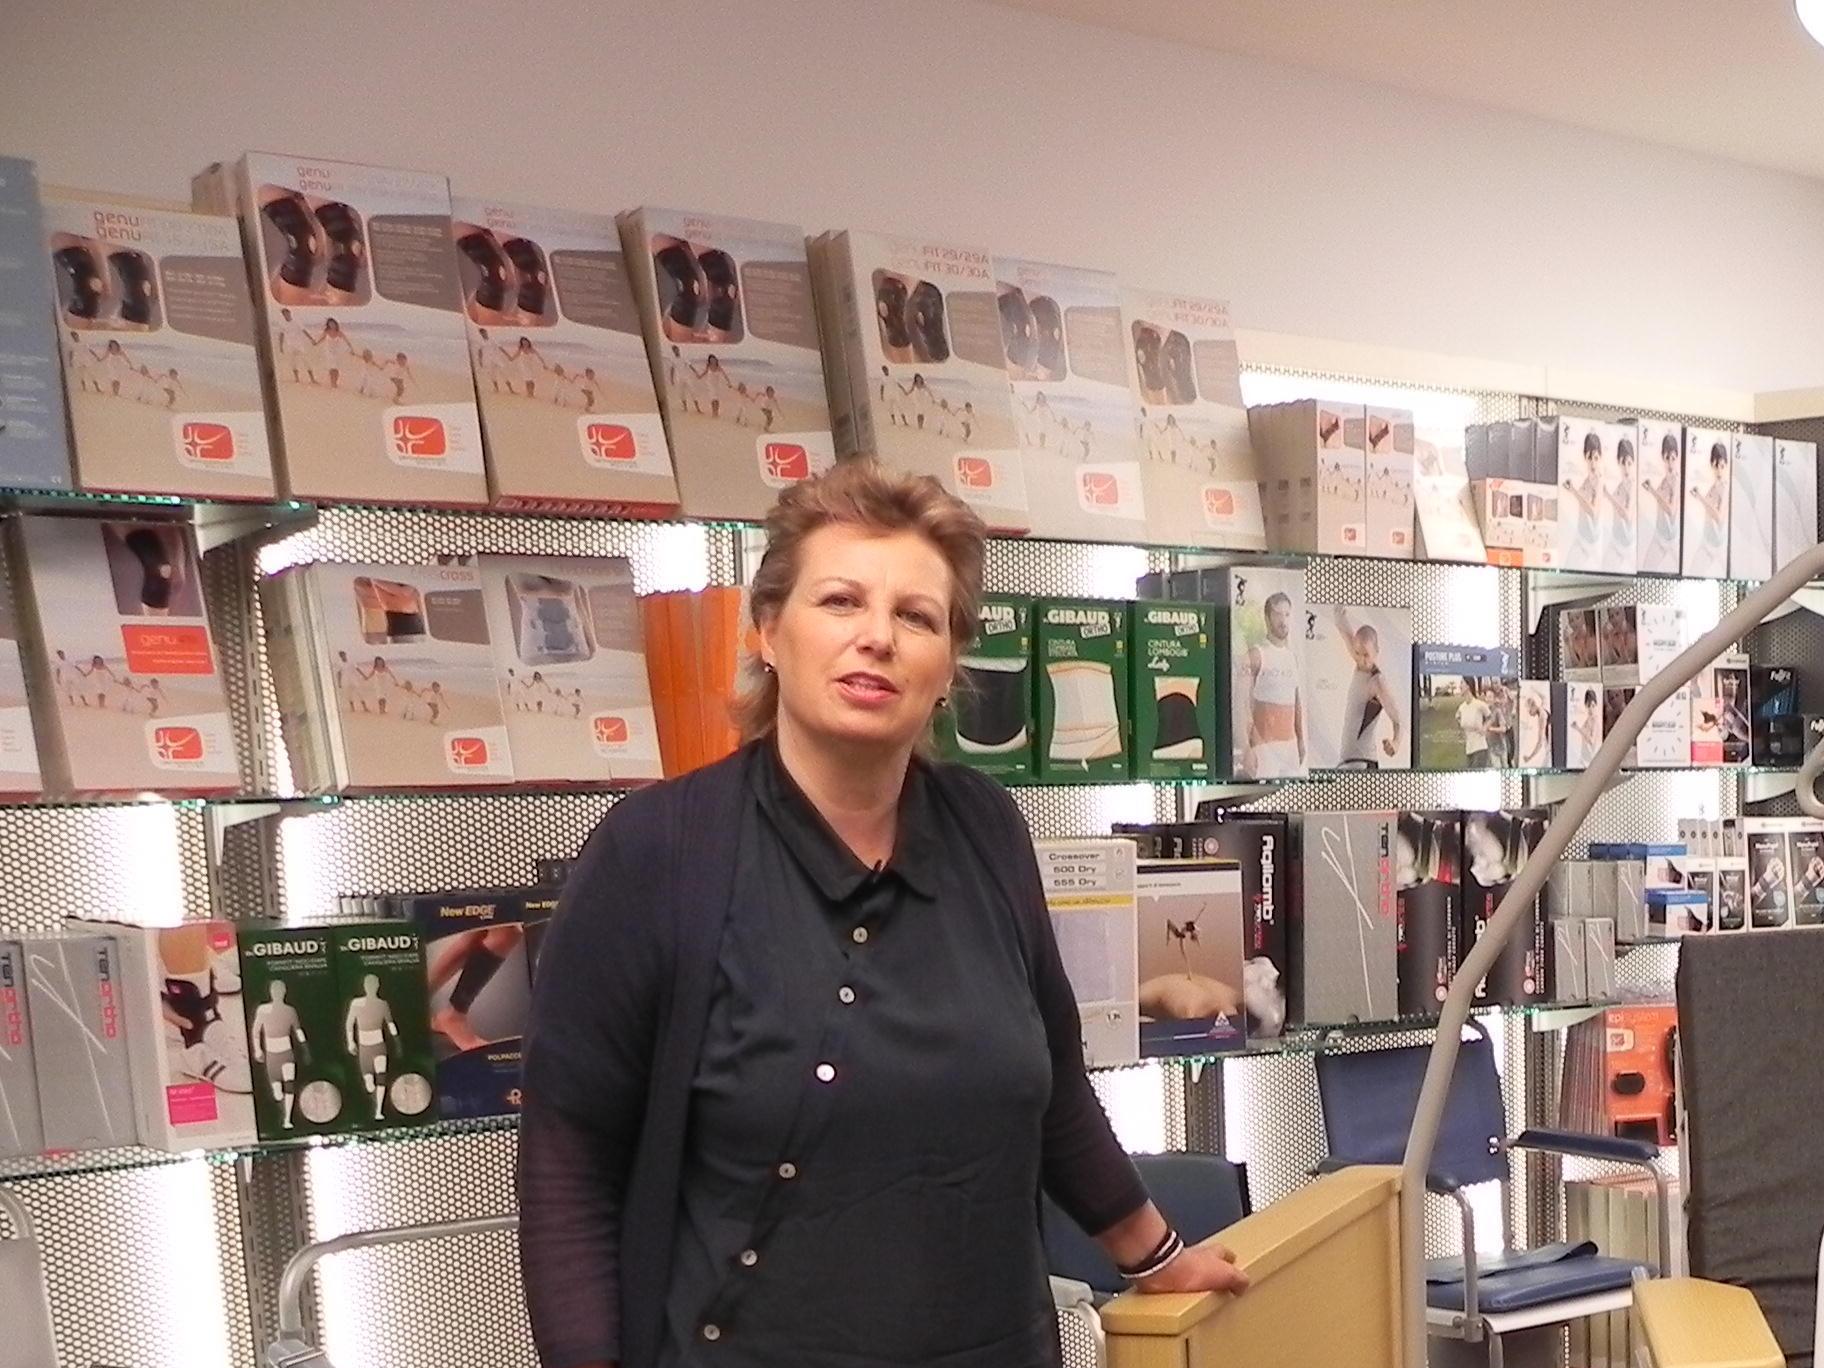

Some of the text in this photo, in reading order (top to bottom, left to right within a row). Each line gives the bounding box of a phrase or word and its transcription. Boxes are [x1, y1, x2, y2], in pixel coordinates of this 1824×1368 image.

[1047, 609, 1110, 625] GIBAUD
[1147, 610, 1198, 625] GIBAUD
[1048, 853, 1100, 861] Crossover
[1078, 865, 1097, 874] Dry
[1078, 878, 1097, 887] Dry
[440, 904, 497, 918] New EDGE
[253, 940, 320, 957] GIBAUD
[347, 935, 412, 952] GIBAUD
